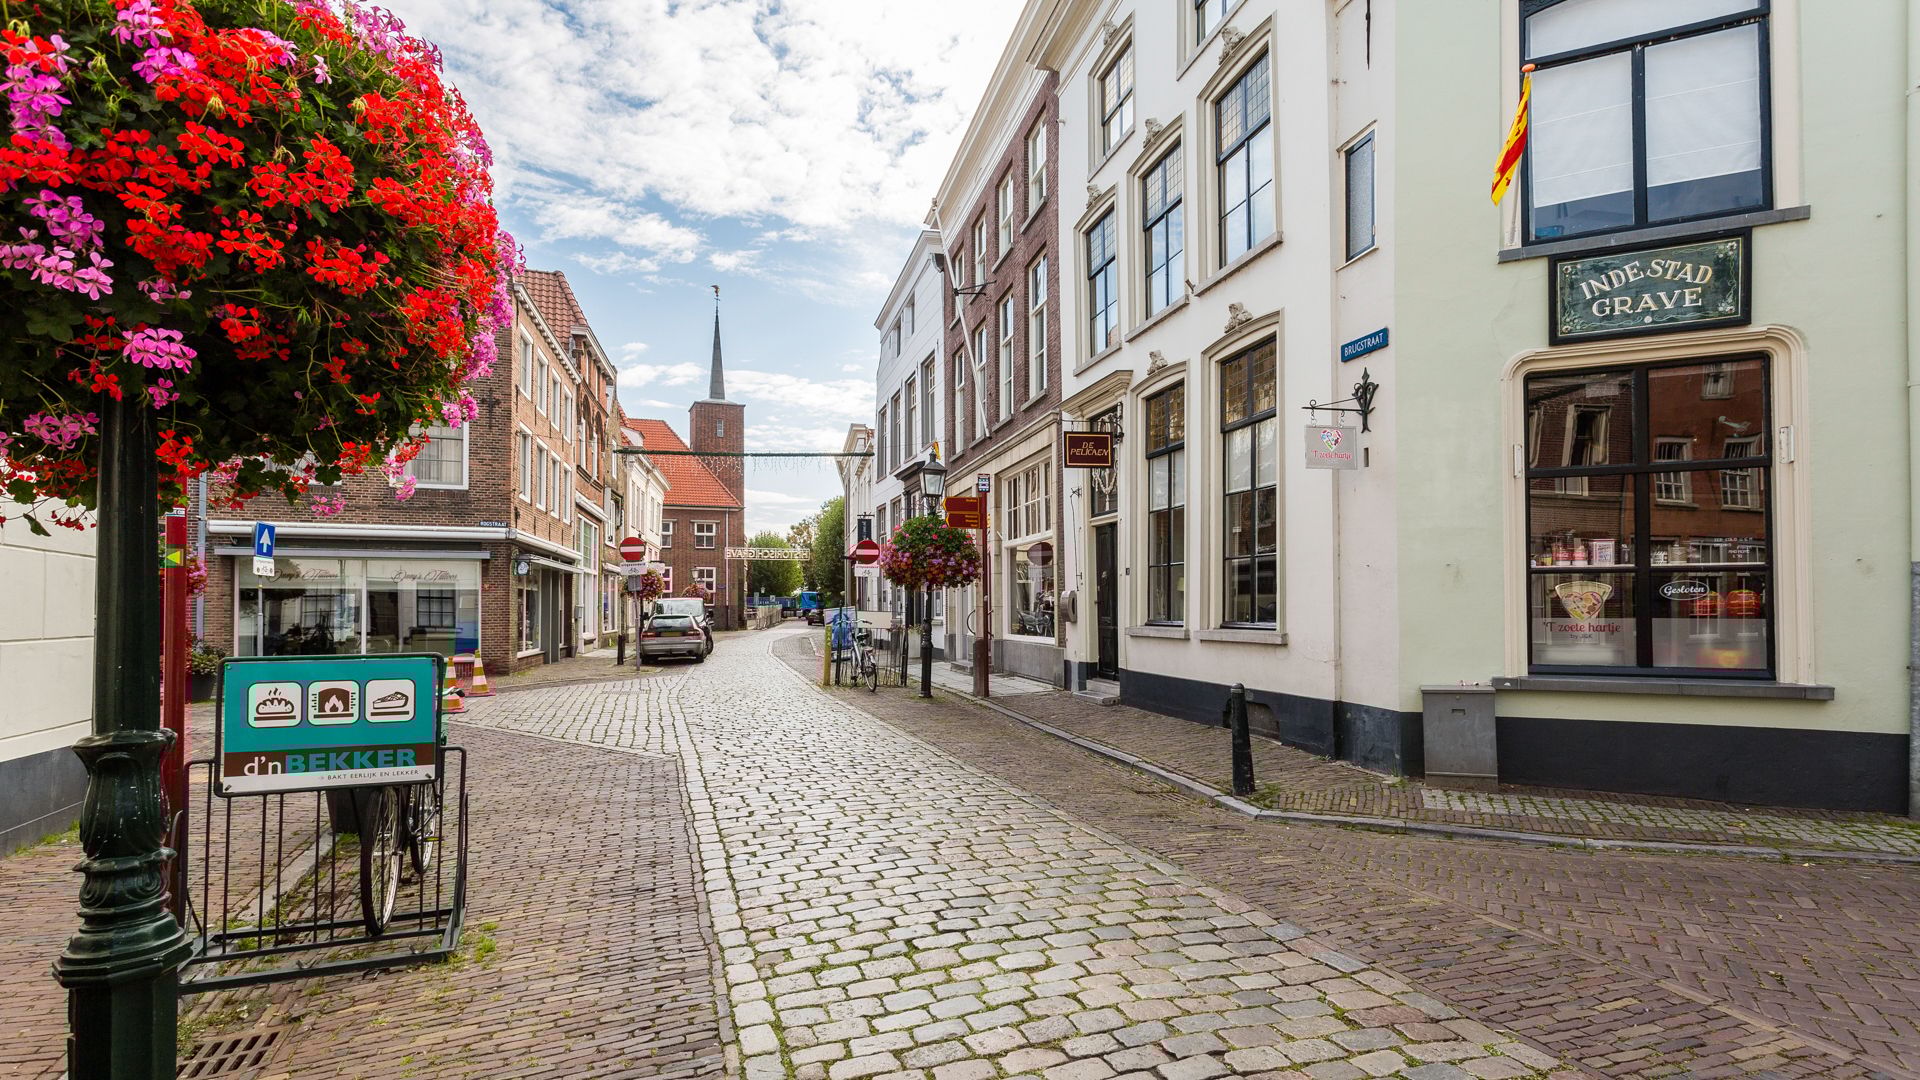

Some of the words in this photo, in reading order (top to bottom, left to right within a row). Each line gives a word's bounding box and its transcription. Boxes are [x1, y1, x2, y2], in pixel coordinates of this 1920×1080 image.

[1645, 258, 1713, 285] STAD
[1591, 286, 1702, 317] GRAVE
[1344, 332, 1384, 357] BRUGSTRAAT
[1081, 441, 1095, 449] DE
[1663, 585, 1705, 596] Gesloten
[1558, 622, 1585, 633] zoete
[1588, 621, 1621, 635] hartje
[327, 773, 347, 781] BAKT
[350, 771, 377, 779] EERLIJK
[392, 769, 419, 777] LEKKER
